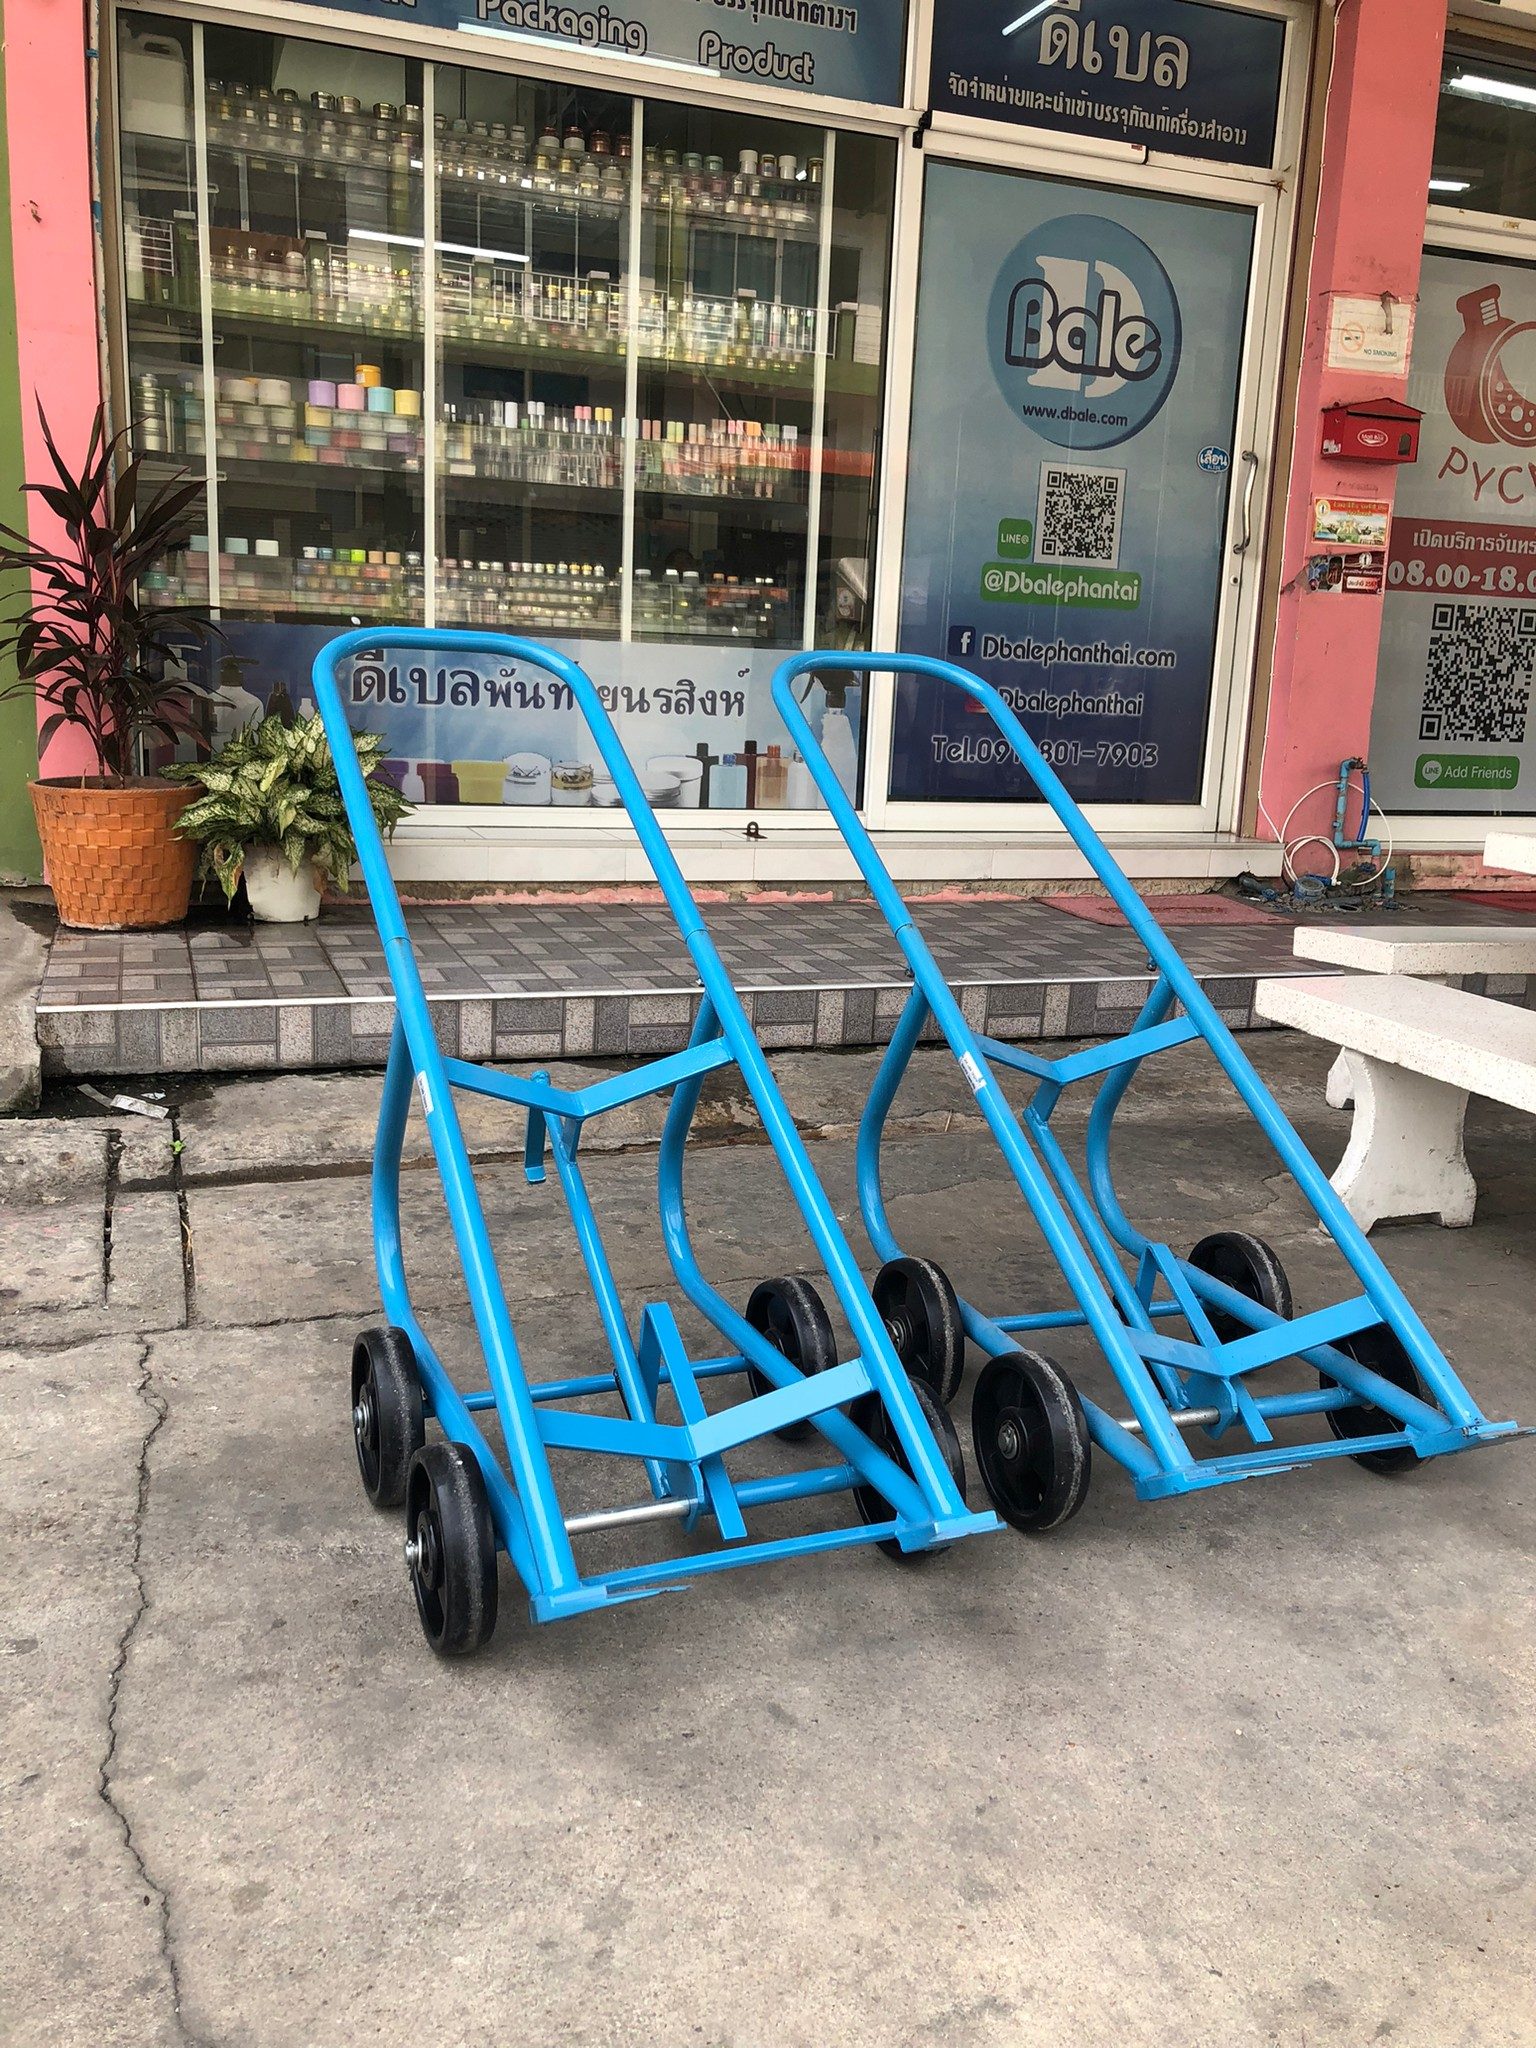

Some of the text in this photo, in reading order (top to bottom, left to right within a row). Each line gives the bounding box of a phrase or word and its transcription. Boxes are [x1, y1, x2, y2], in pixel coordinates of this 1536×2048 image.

[477, 0, 648, 56] Packaging
[698, 30, 815, 85] Product
[1005, 278, 1162, 381] Bale
[1022, 404, 1128, 427] www.dbale.com
[1000, 533, 1030, 545] LINE@
[1413, 529, 1536, 556] เปิดบริการจันทร
[983, 569, 1139, 603] @Dbalephantai
[982, 635, 1176, 668] Dbalephanthai.com
[1000, 688, 1144, 719] Dbalephanthai
[1425, 765, 1513, 780] LINE Add Friends
